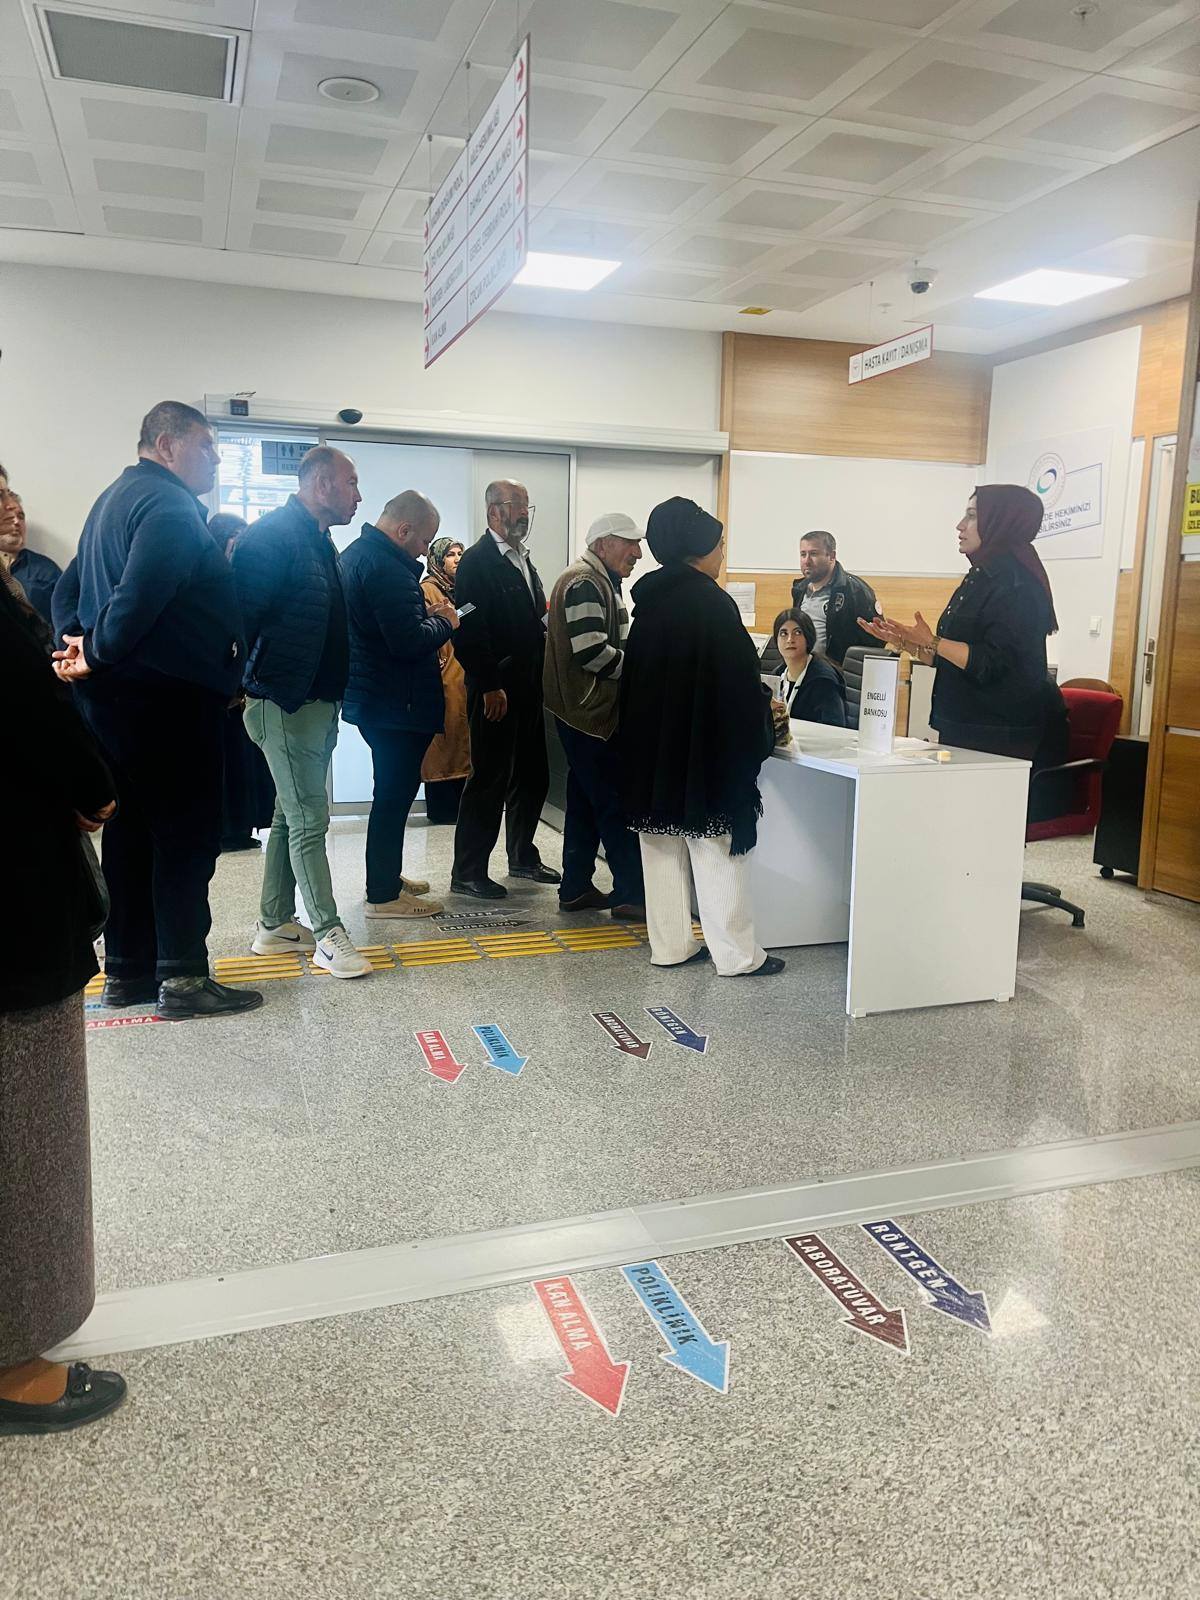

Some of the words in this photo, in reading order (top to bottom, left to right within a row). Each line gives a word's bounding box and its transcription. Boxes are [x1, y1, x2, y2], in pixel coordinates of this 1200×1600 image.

[864, 354, 881, 370] HASTA
[882, 348, 898, 365] KAYIT
[901, 337, 928, 359] DANIŞMA
[1055, 502, 1091, 518] HEKİMİNİZİ
[867, 691, 887, 701] ENGELLİ
[863, 707, 888, 718] BANKOSU
[112, 1016, 153, 1026] ALMA
[650, 1007, 688, 1036] RÖNTGEN
[422, 1032, 438, 1044] KAN
[427, 1044, 446, 1061] ALMA
[480, 1026, 510, 1059] POLİKLİNİK
[870, 1223, 949, 1290] RÖNTGEN
[795, 1237, 887, 1326] LABORATUVAR
[543, 1281, 571, 1310] KAN
[557, 1311, 593, 1351] ALMA
[631, 1266, 699, 1346] POLİKLİNİK
